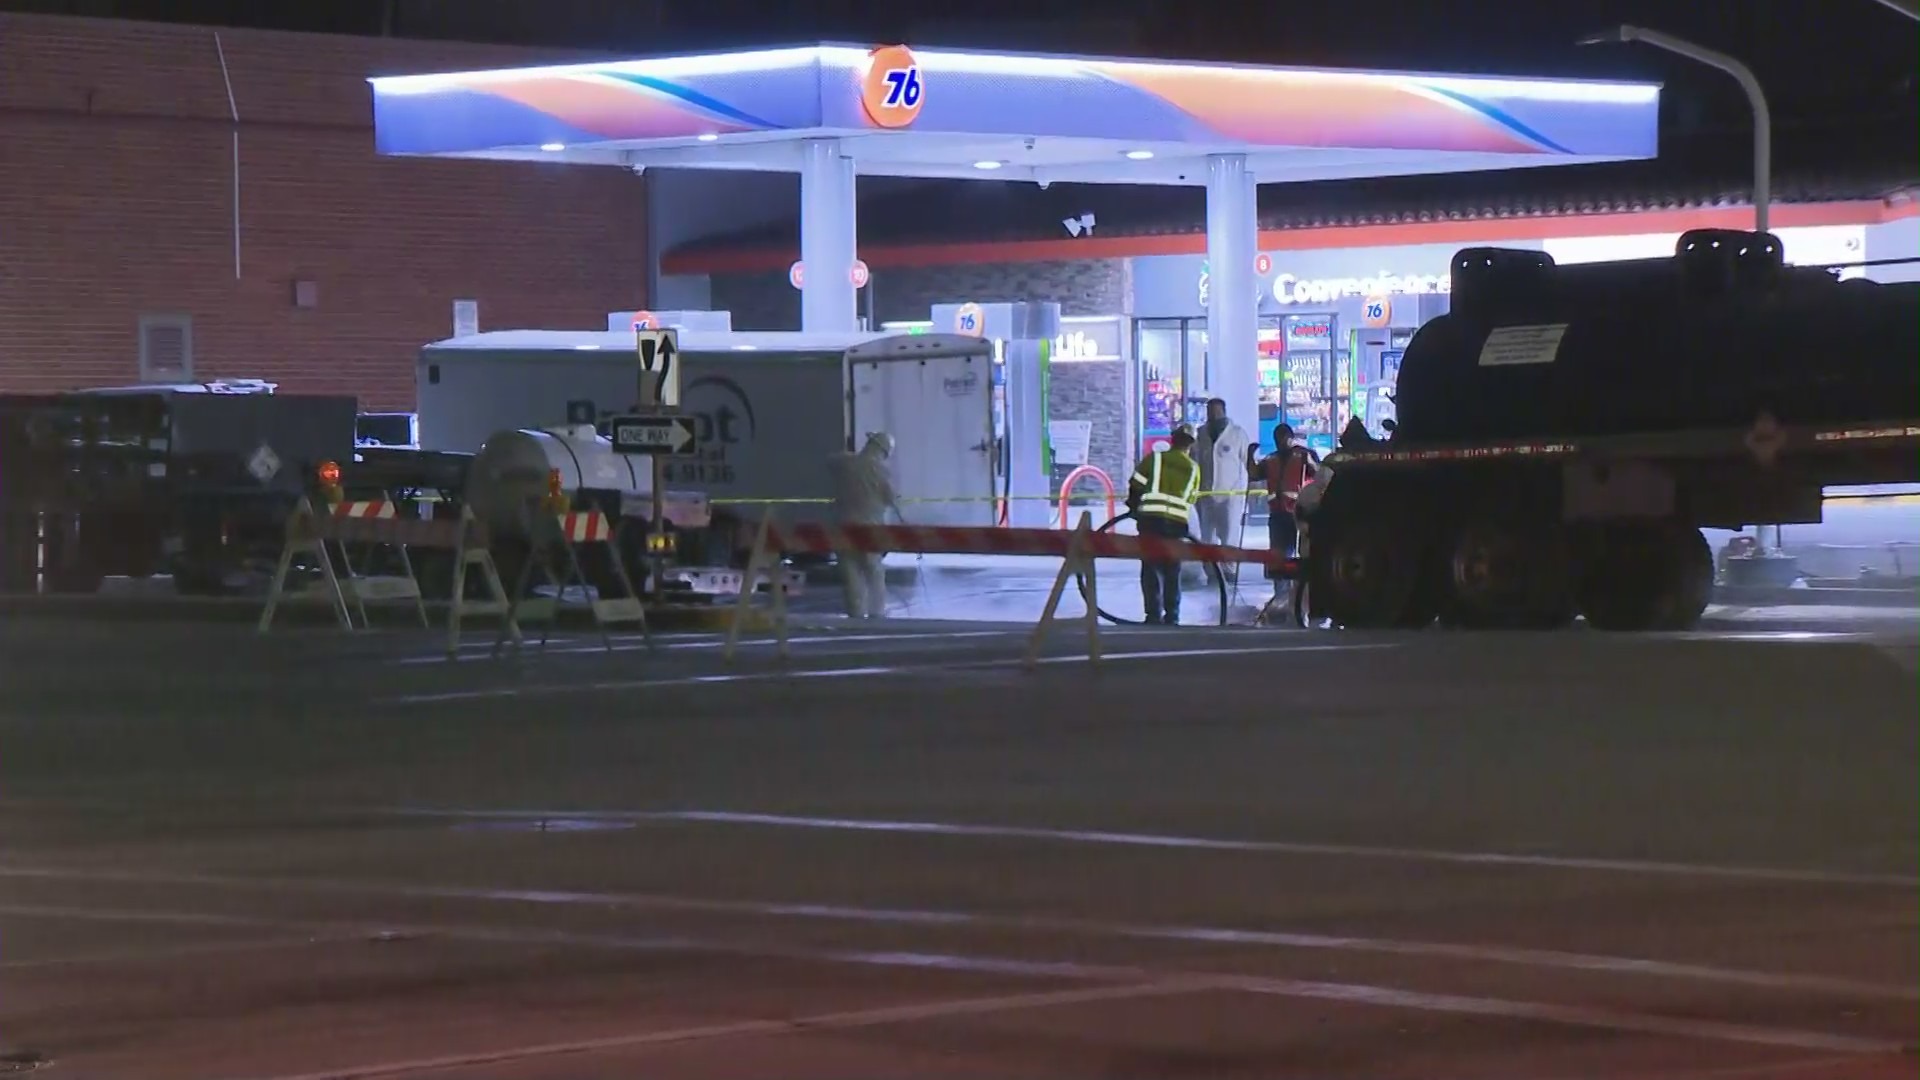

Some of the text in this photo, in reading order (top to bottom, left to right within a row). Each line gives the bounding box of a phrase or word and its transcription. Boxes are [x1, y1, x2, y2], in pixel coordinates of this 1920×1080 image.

[885, 67, 921, 107] 76
[1258, 258, 1268, 271] 8
[1366, 303, 1383, 319] 76
[959, 312, 976, 330] 76
[620, 428, 671, 443] ONE WAY
